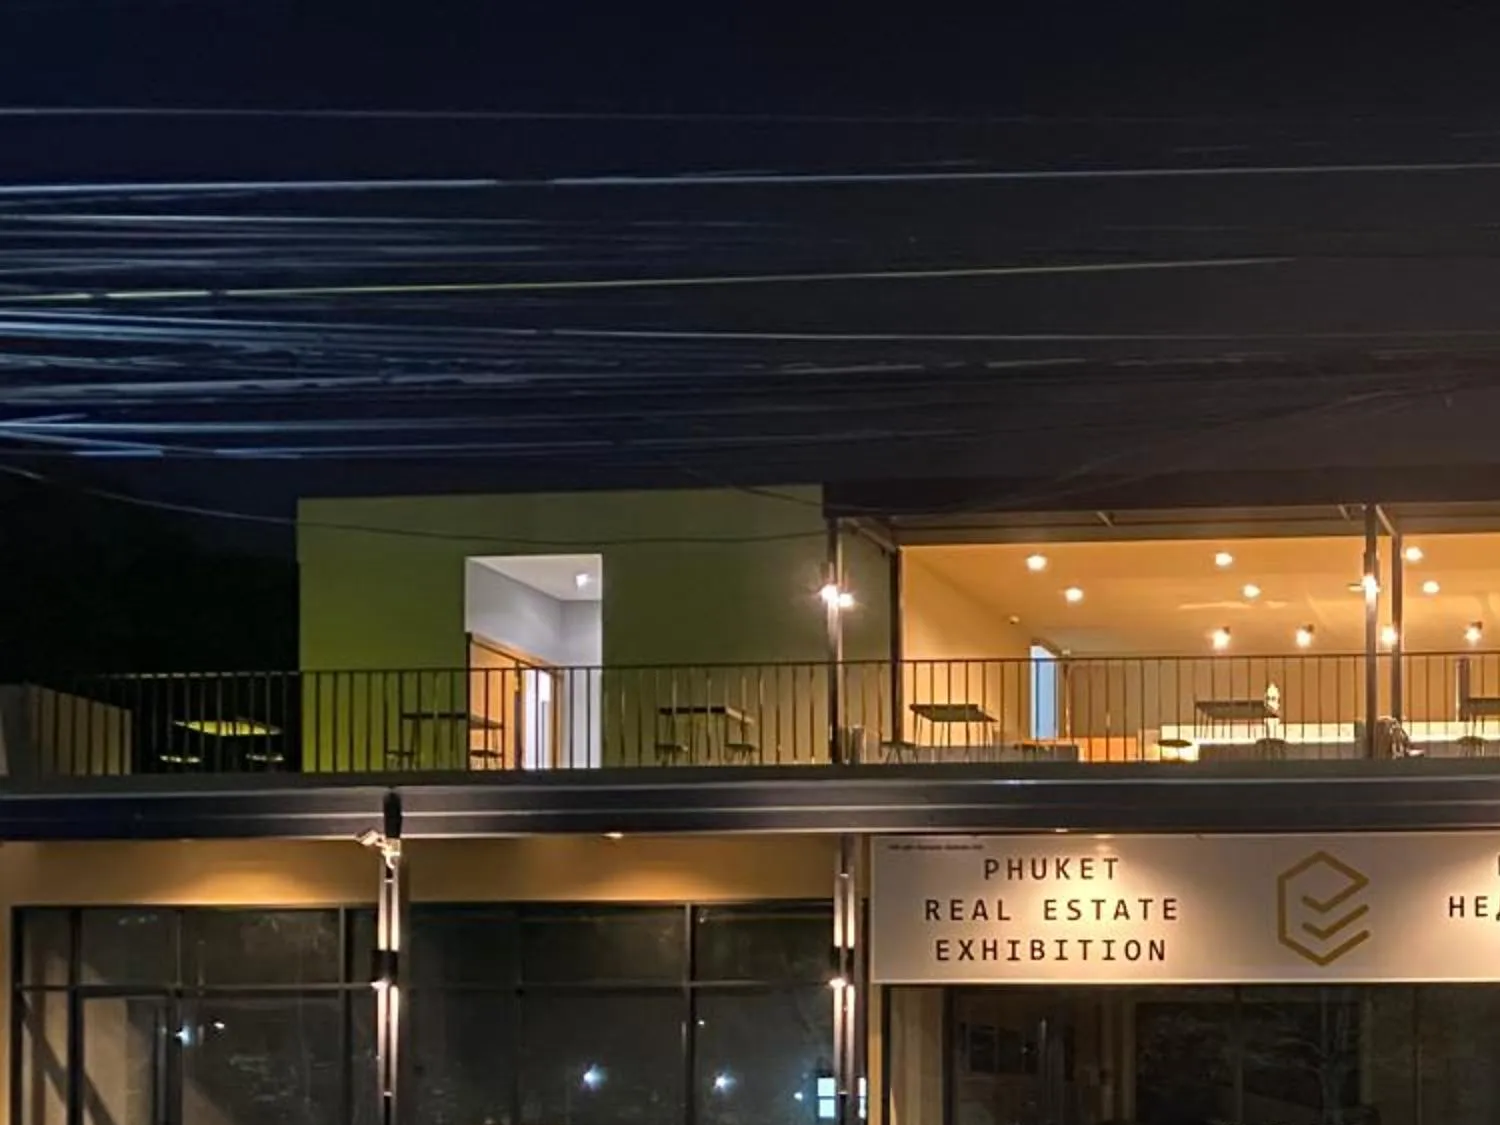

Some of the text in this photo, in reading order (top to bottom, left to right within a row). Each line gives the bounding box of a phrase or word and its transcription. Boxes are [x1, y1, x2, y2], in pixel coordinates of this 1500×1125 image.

[984, 857, 1120, 881] PHUKET
[925, 898, 1179, 921] REAL ESTATE
[935, 938, 1167, 962] EXHIBITION
